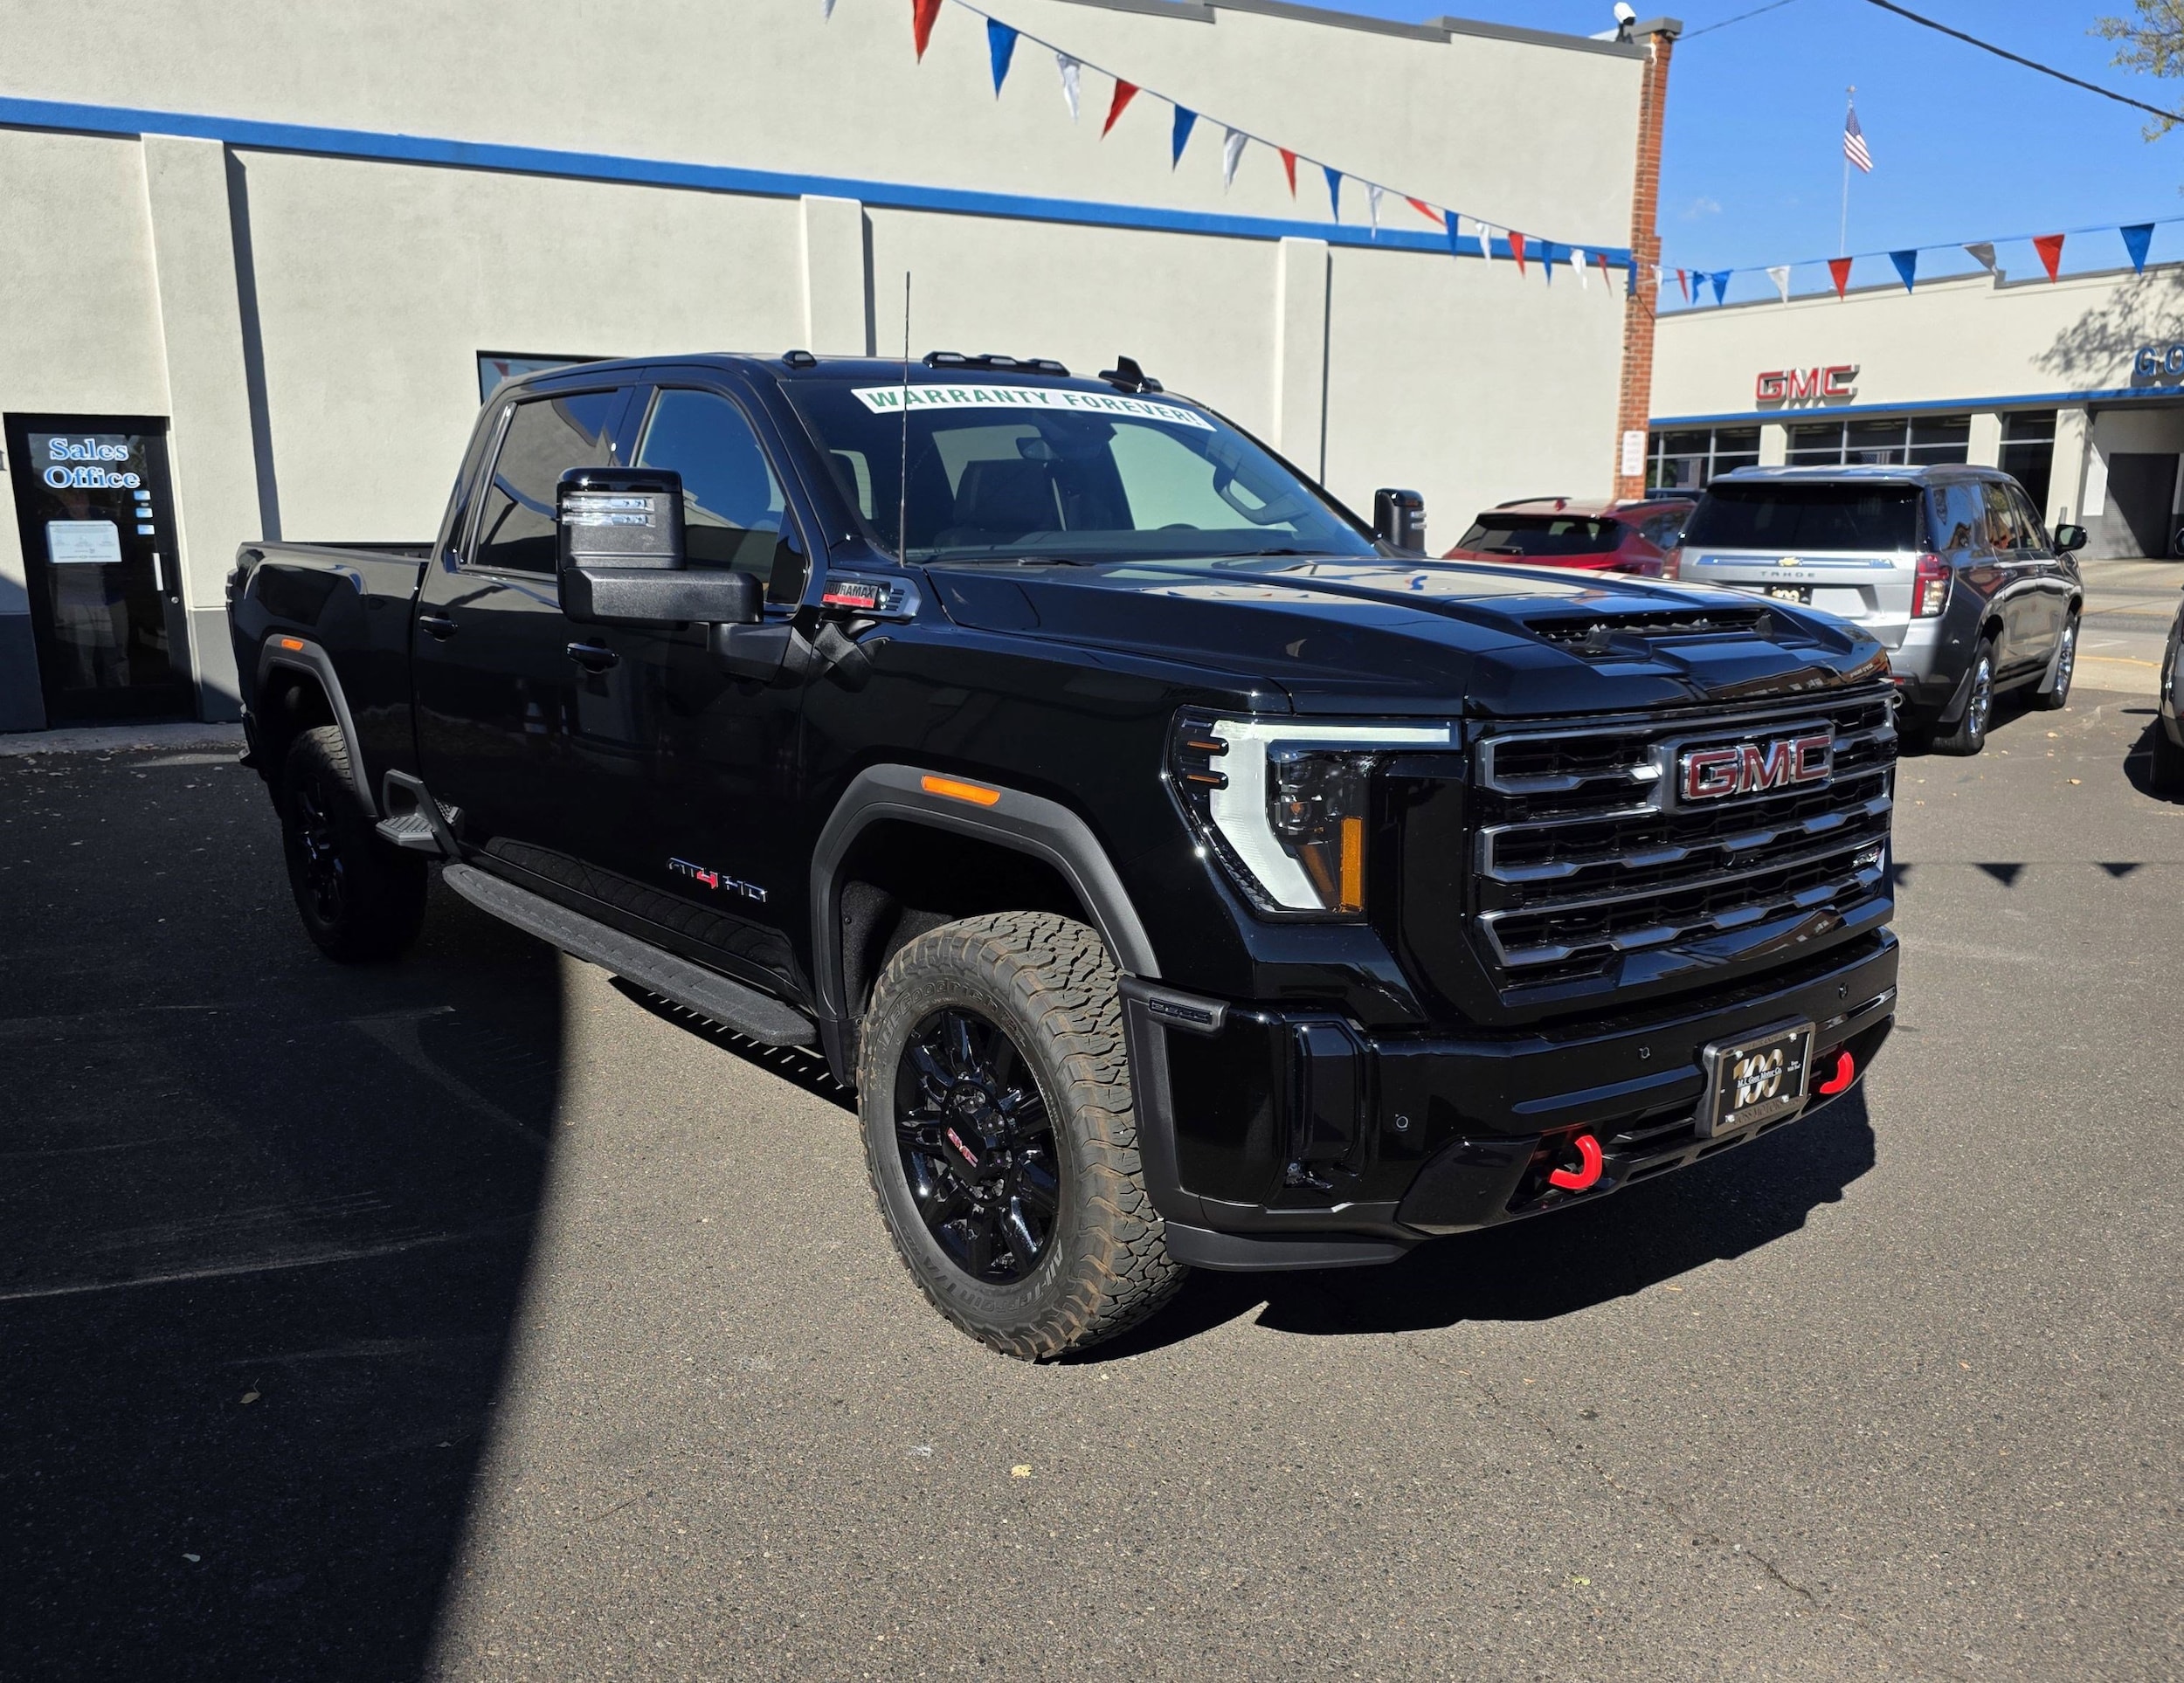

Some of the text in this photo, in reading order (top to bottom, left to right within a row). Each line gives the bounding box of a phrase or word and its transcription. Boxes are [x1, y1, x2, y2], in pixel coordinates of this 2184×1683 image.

[1755, 364, 1860, 402] GMC
[866, 389, 1202, 426] WARRANTY FOREVER!
[49, 438, 129, 461] Sales
[44, 466, 141, 488] Office
[826, 583, 875, 599] DURAMAX
[1685, 735, 1831, 800] GMC
[1732, 1048, 1784, 1109] 100
